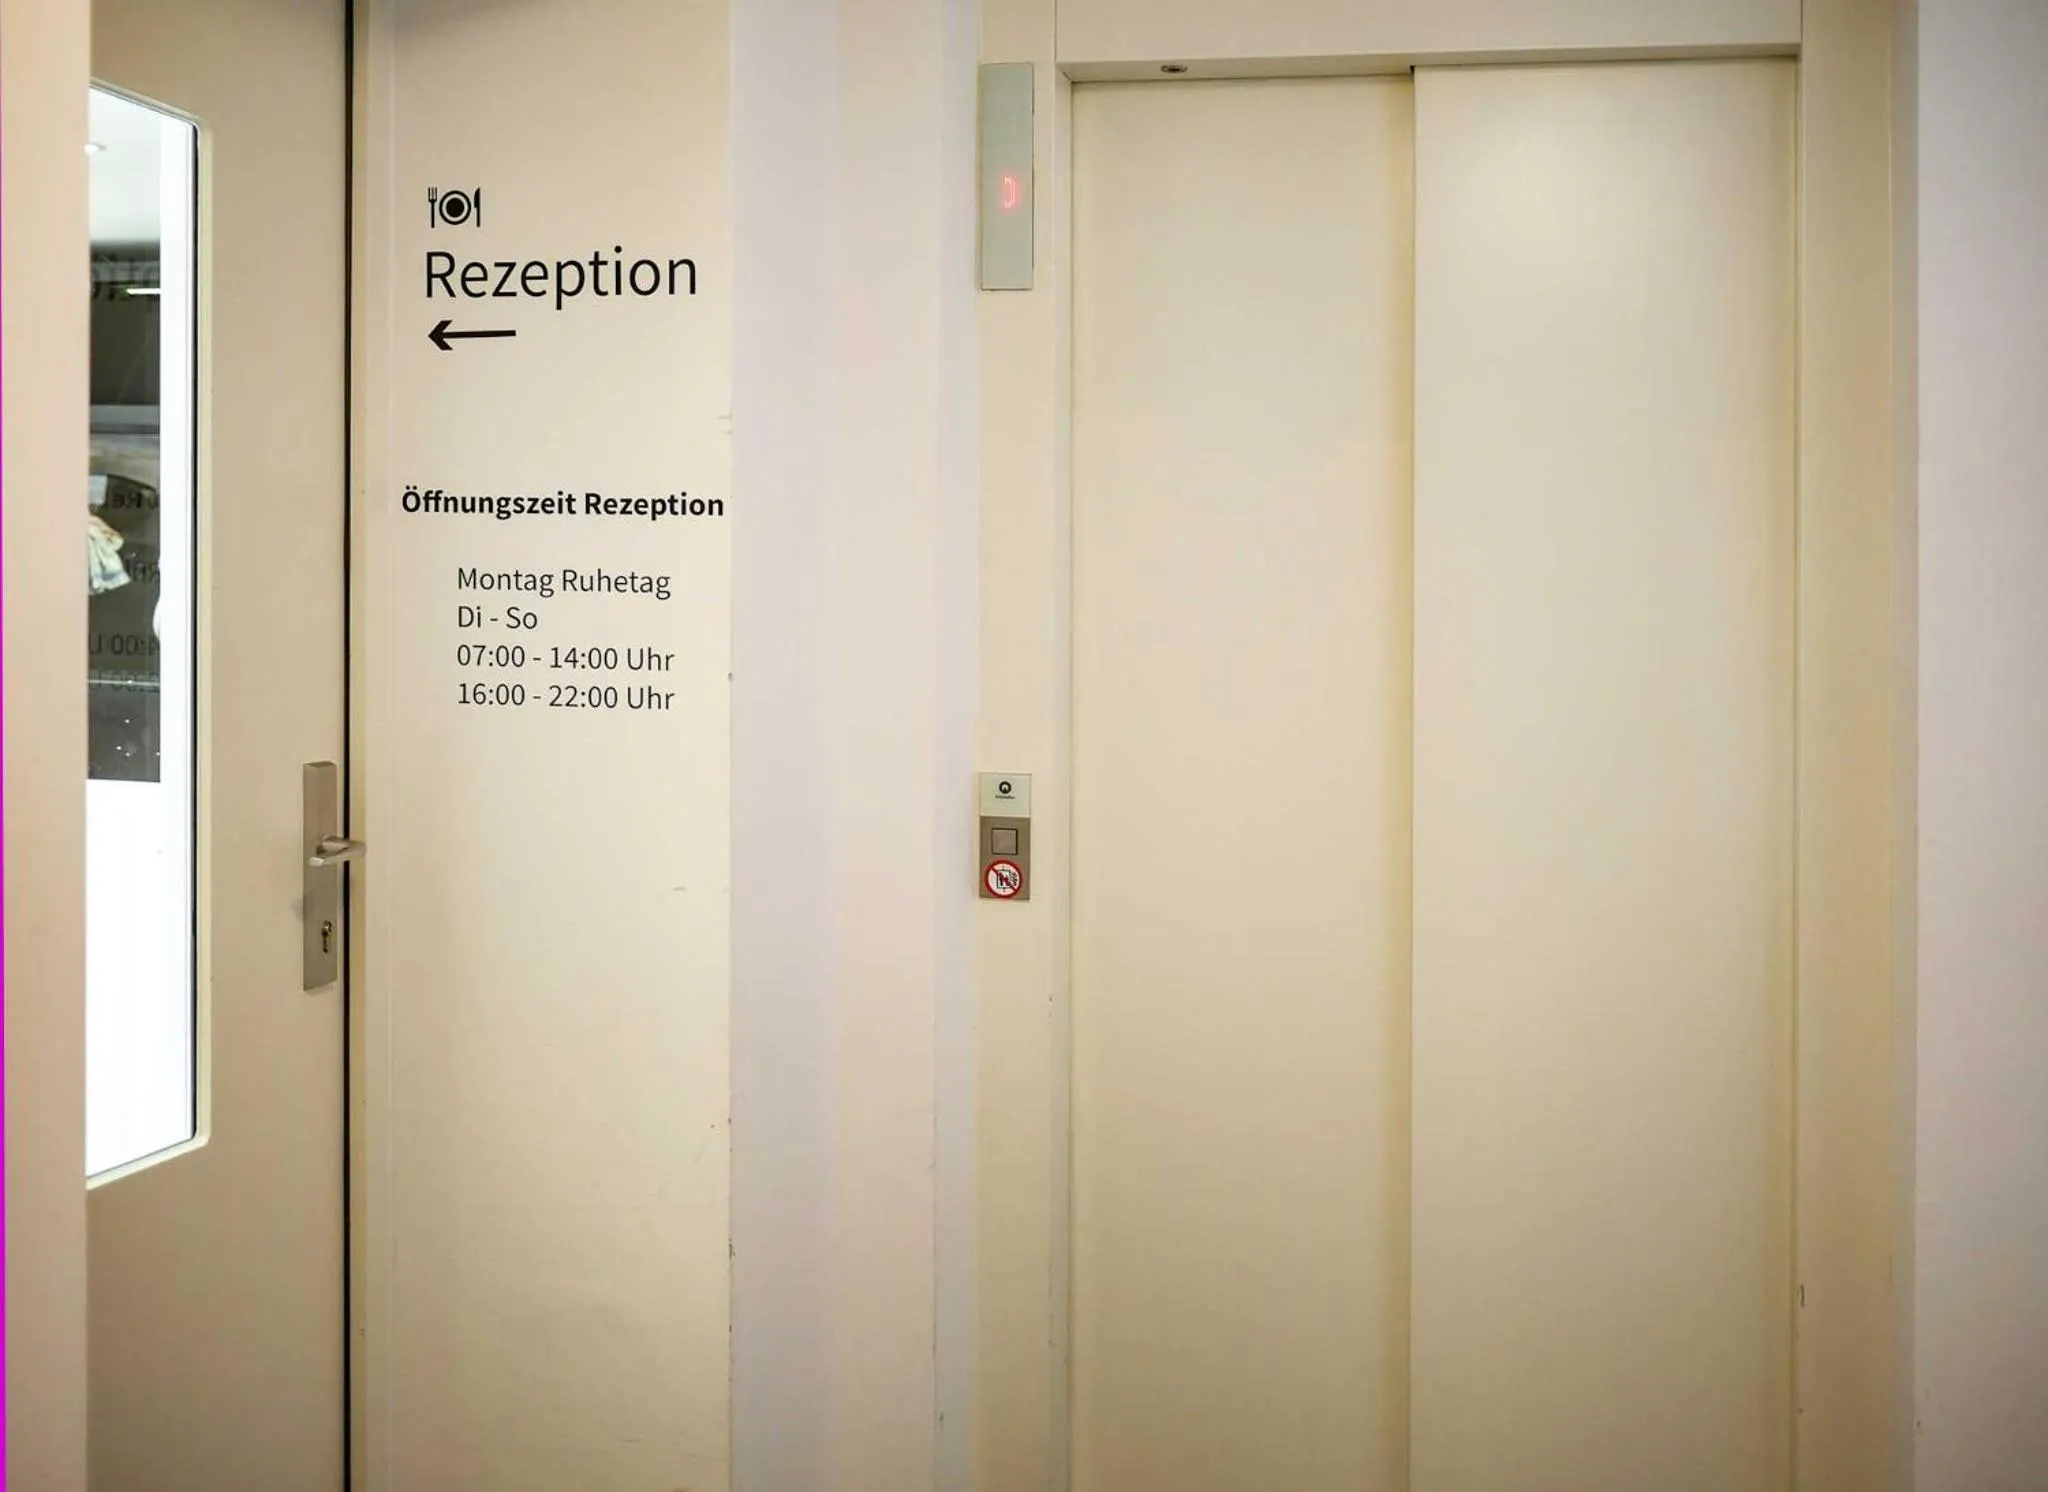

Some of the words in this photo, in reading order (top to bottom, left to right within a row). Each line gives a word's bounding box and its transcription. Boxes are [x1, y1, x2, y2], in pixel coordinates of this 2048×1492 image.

[426, 246, 697, 310] Rezeption
[402, 486, 576, 520] Öffnungszeit
[586, 493, 724, 521] Rezeption
[458, 568, 554, 598] Montag
[562, 569, 671, 600] Ruhetag
[458, 606, 482, 628] Di
[505, 606, 538, 629] So
[457, 645, 525, 667] 07:00
[549, 647, 618, 669] 14:00
[627, 647, 675, 671] Uhr
[458, 683, 525, 705] 16:00
[549, 685, 618, 708] 22:00
[627, 686, 675, 709] Uhr
